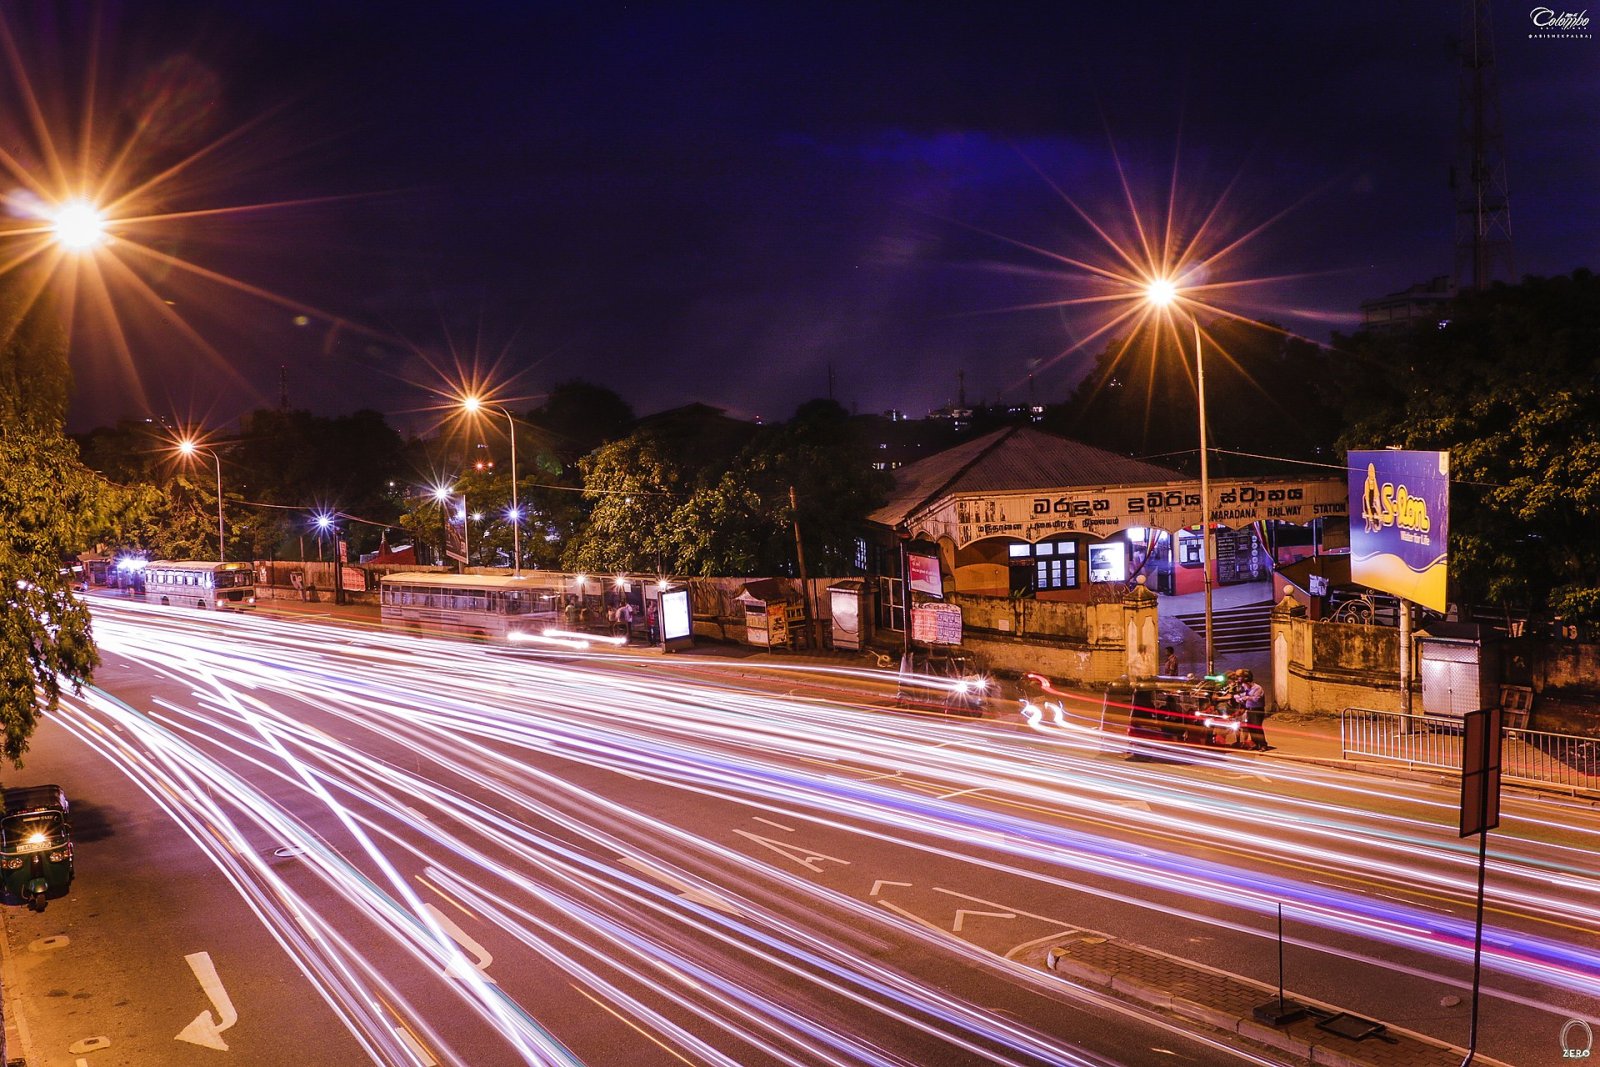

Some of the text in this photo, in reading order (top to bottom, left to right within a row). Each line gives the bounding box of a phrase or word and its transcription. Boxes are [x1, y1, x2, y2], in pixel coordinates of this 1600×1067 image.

[1210, 503, 1346, 521] MARADANA RAILWAY STATION
